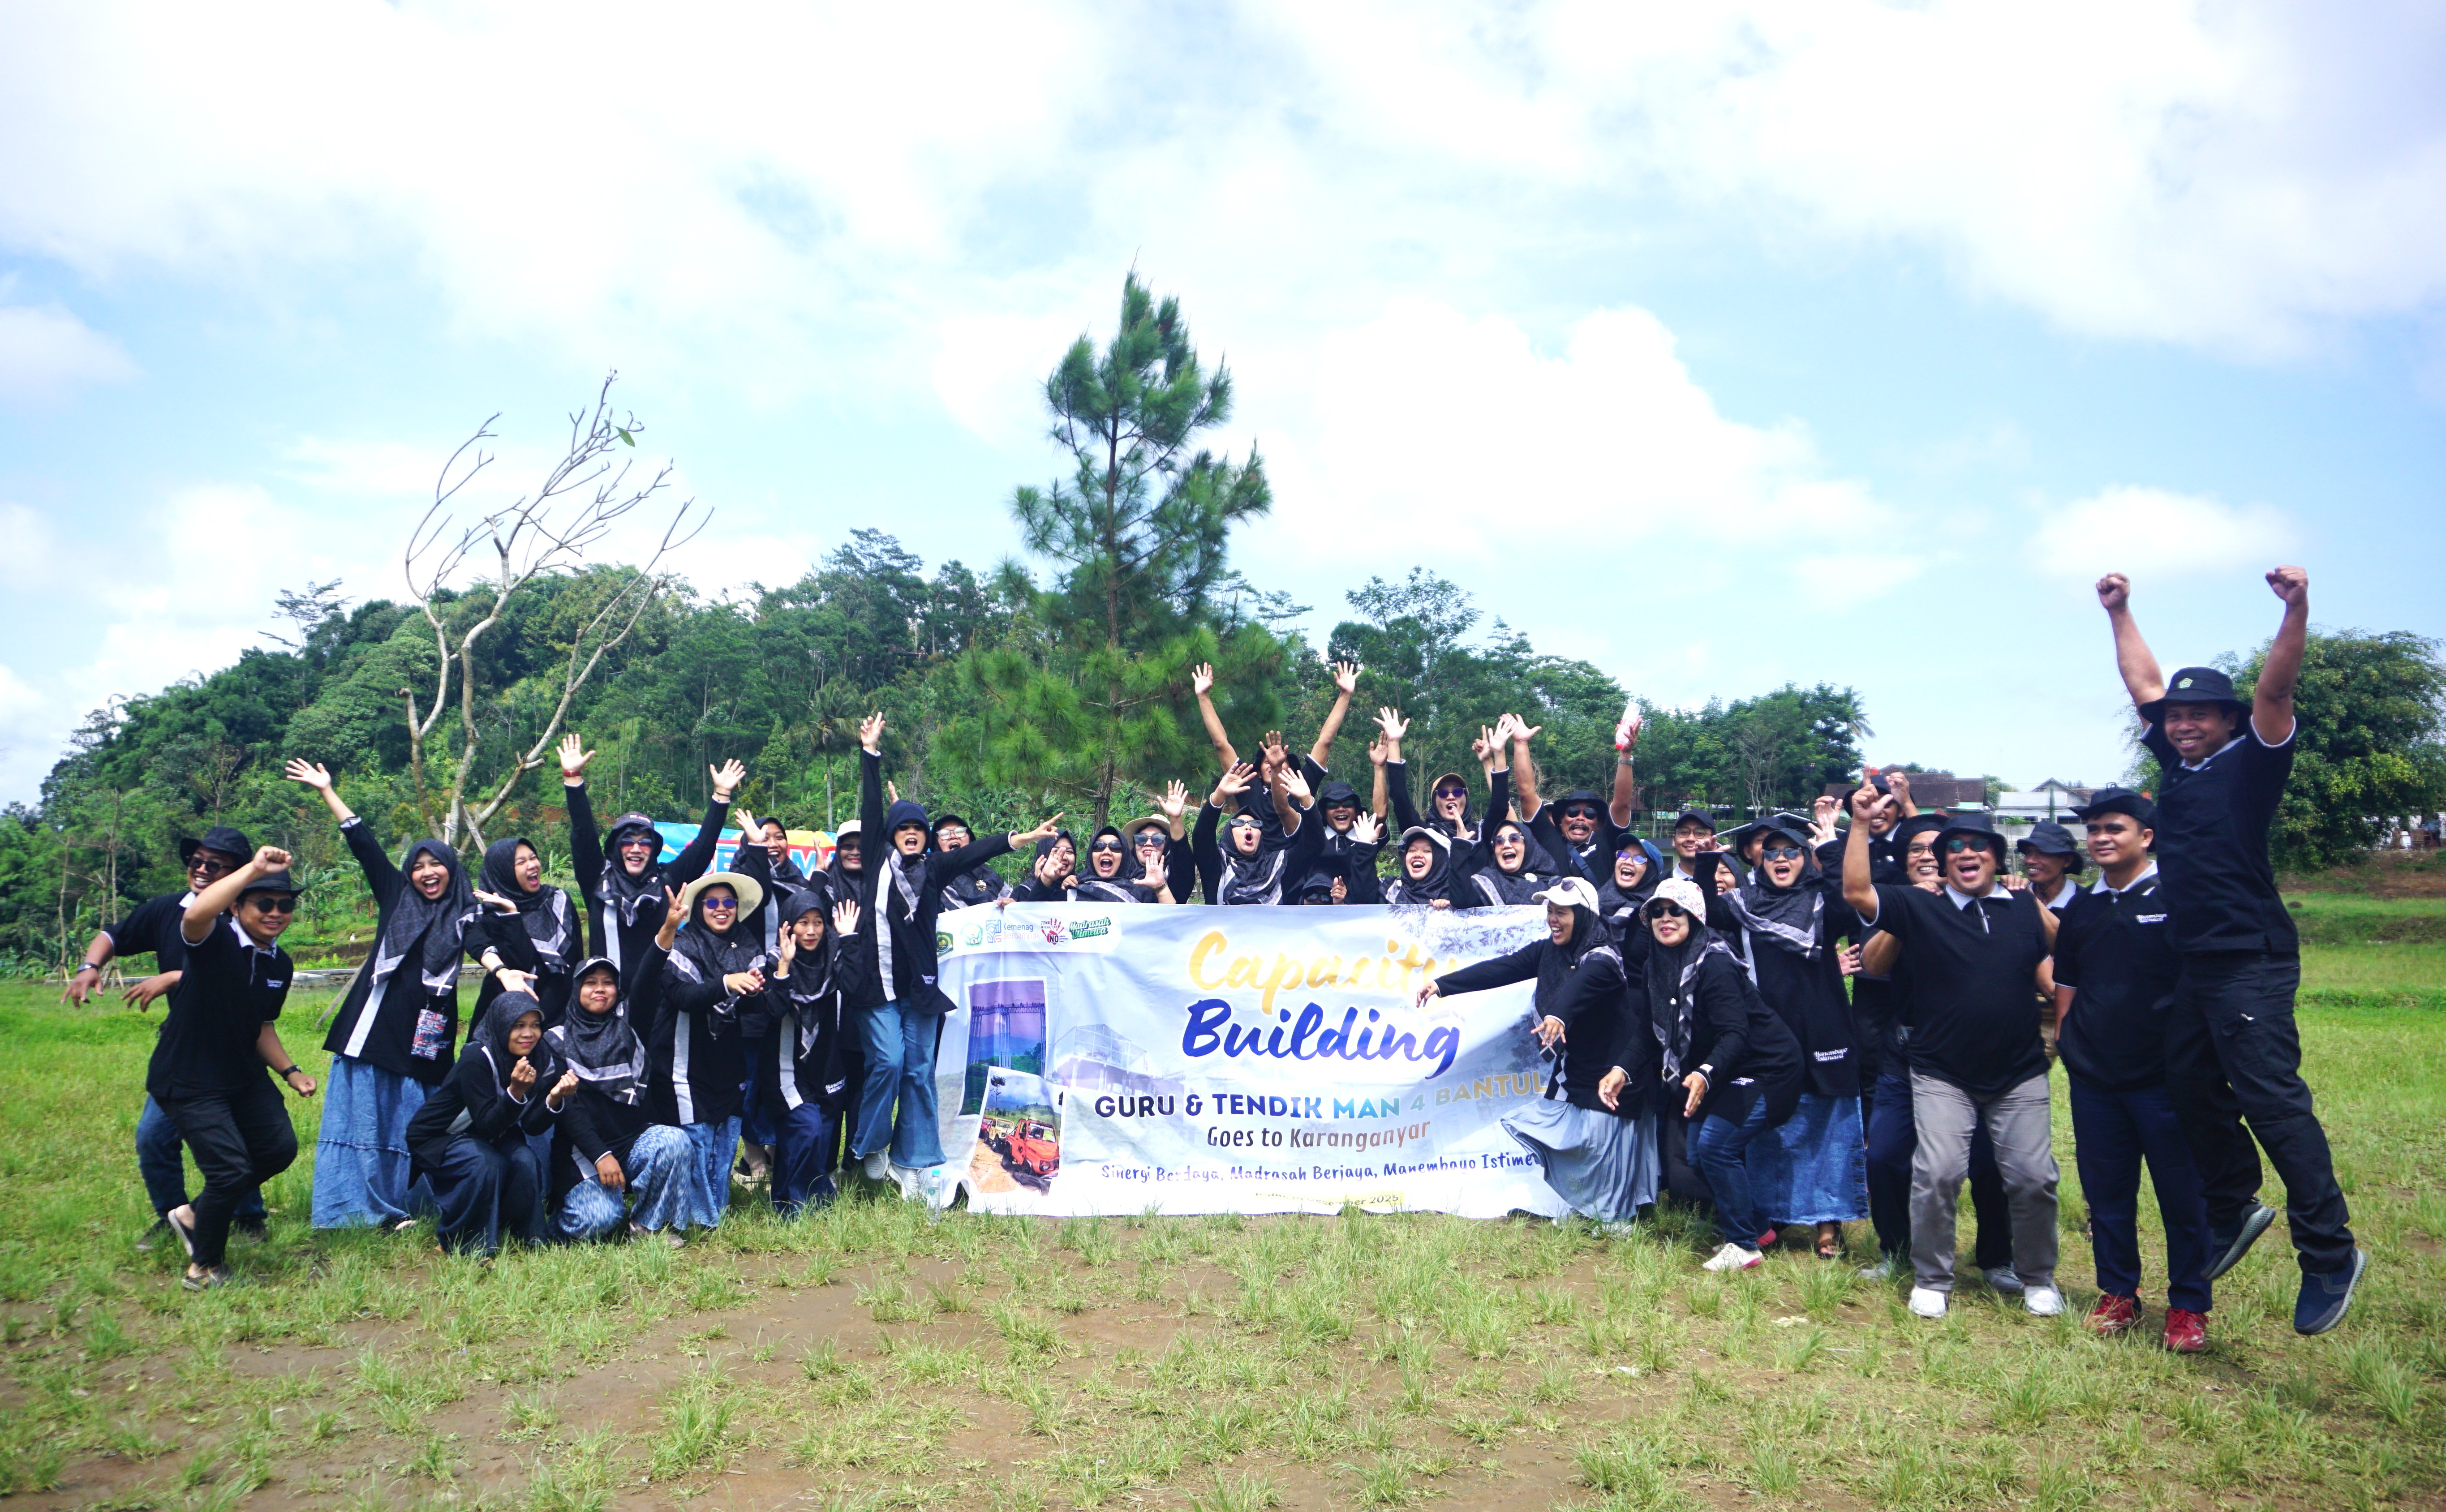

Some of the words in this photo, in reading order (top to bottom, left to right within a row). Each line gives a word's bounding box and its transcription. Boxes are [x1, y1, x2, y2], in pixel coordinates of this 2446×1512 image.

[1050, 935, 1059, 943] NO
[1069, 917, 1111, 932] Madrasah
[1182, 999, 1460, 1080] Building
[1095, 1095, 1175, 1118] GURU
[1186, 1094, 1203, 1116] &
[1212, 1093, 1323, 1119] TENDIK
[1333, 1097, 1400, 1119] MAN
[1410, 1094, 1426, 1111] 4
[1435, 1071, 1548, 1107] BANTUL
[1208, 1126, 1254, 1147] Goes
[1262, 1127, 1282, 1147] to
[1290, 1120, 1431, 1152] Karanganyar
[1102, 1165, 1150, 1183] Sinergi
[1230, 1166, 1306, 1180] Madrasah
[1313, 1164, 1378, 1182] Berjaya,
[1481, 1152, 1540, 1168] Istime
[1369, 1194, 1399, 1204] 2025
